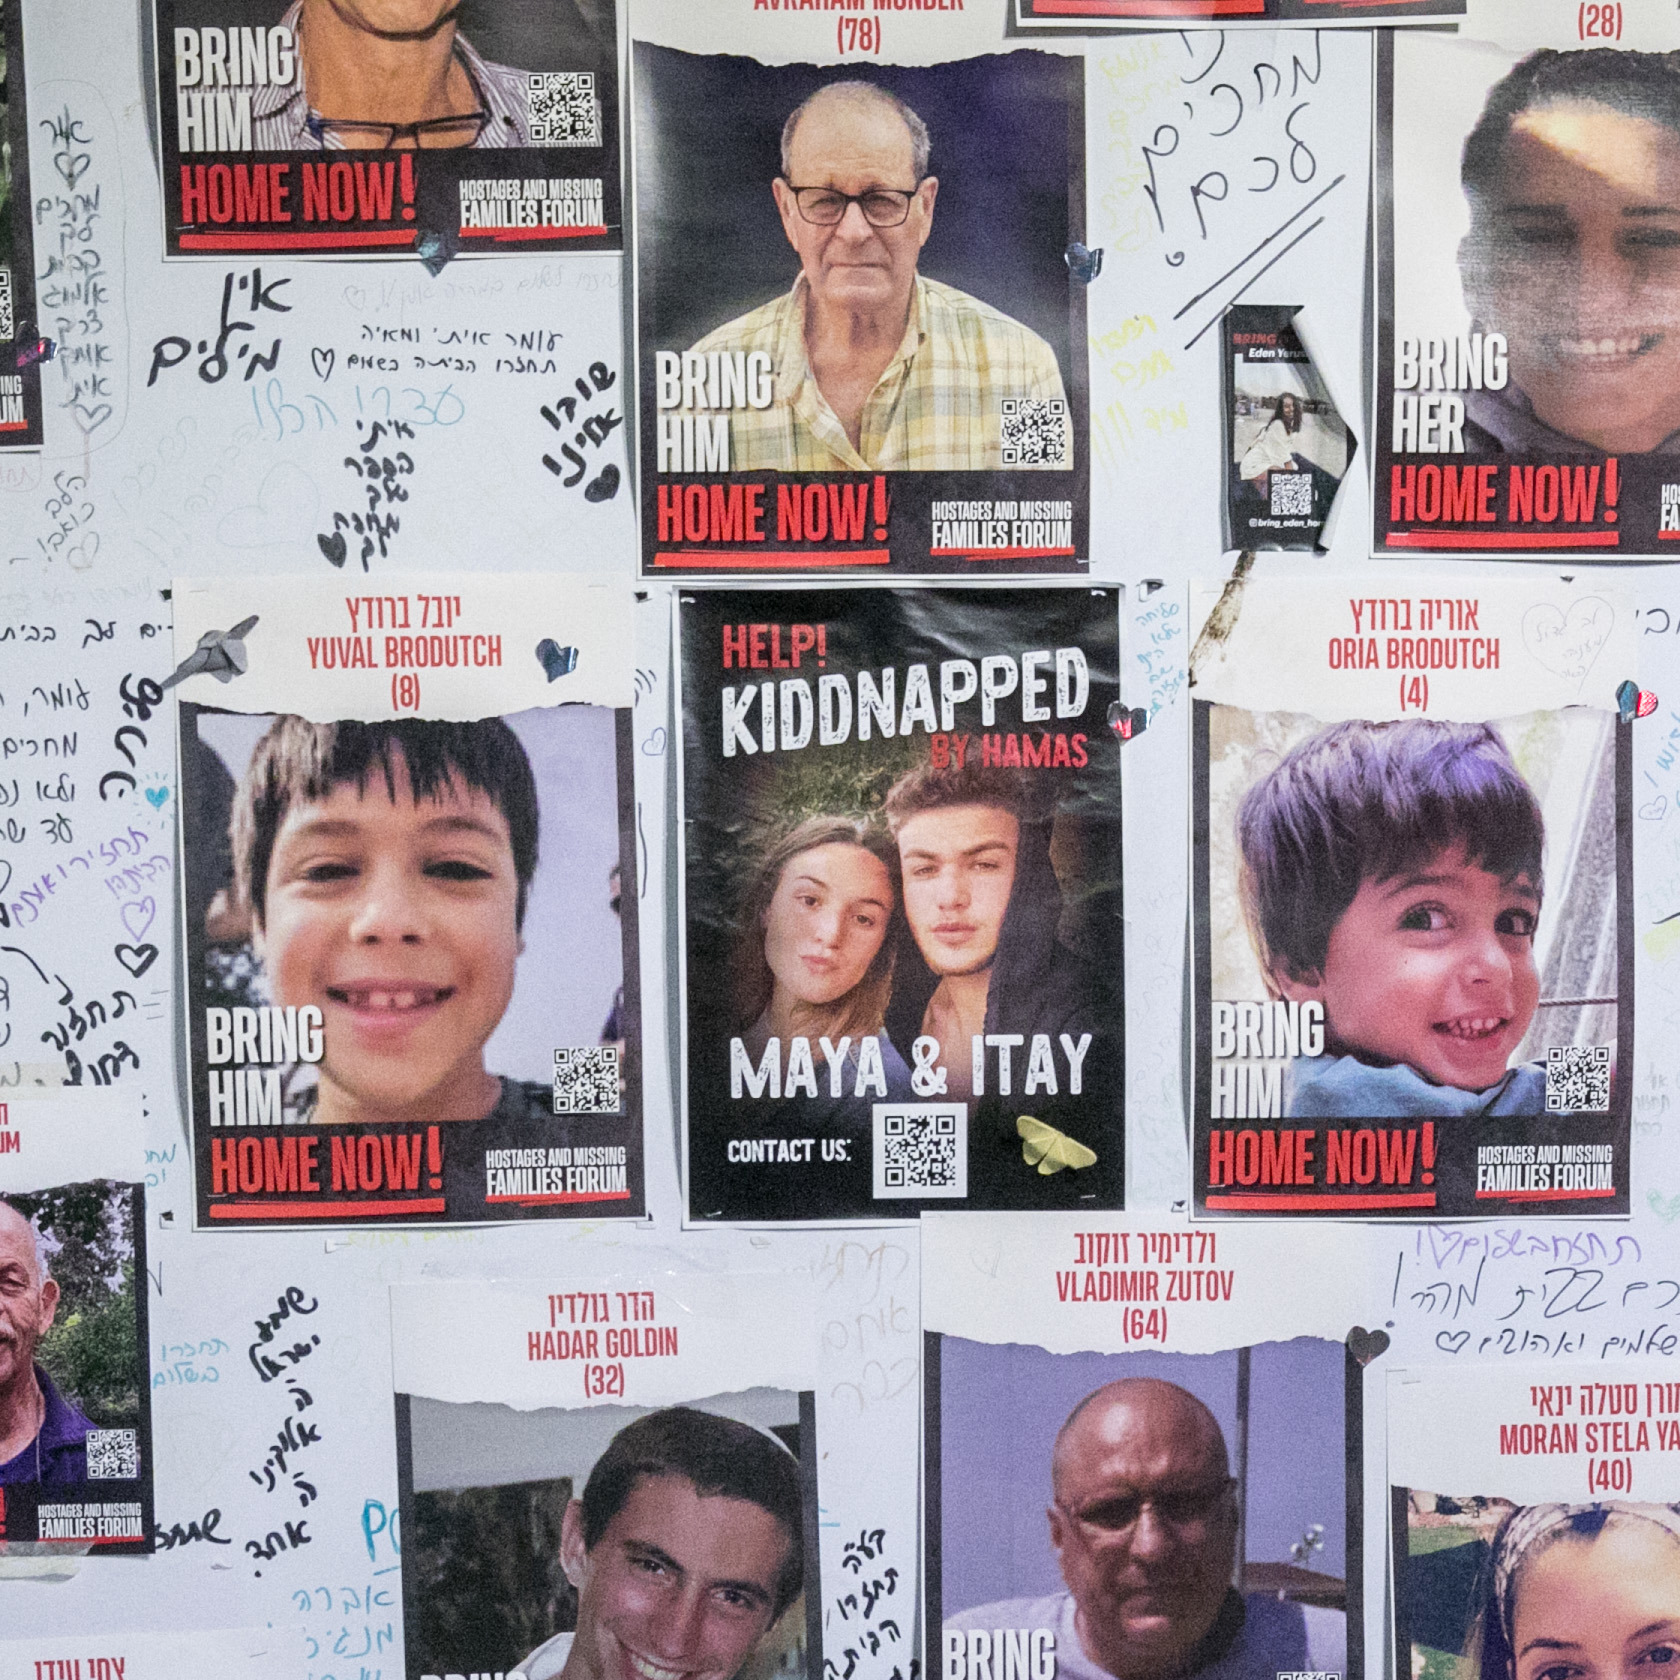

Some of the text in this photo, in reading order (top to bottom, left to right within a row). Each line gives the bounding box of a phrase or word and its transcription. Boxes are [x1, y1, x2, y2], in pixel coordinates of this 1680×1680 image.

[220, 267, 293, 330] אין
[147, 317, 283, 389] מילים
[306, 634, 502, 670] YUVAL BRODUTCH
[722, 623, 827, 669] HELP!
[1328, 637, 1500, 670] ORIA BRODUTCH
[390, 672, 421, 711] (8)
[721, 646, 1090, 758] KIDDNAPPED
[1399, 674, 1429, 712] (4)
[930, 734, 1089, 769] BY HAMAS
[729, 1033, 1093, 1099] MAYA & ITAY
[727, 1138, 852, 1163] CONTACT US:
[1055, 1269, 1234, 1303] VLADIMIR ZUTOV
[1122, 1307, 1168, 1343] (64)
[527, 1327, 678, 1361] HADAR GOLDIN
[583, 1362, 625, 1397] (32)
[1499, 1423, 1578, 1455] MORAN
[1585, 1420, 1650, 1454] STELA
[1587, 1457, 1633, 1494] (40)
